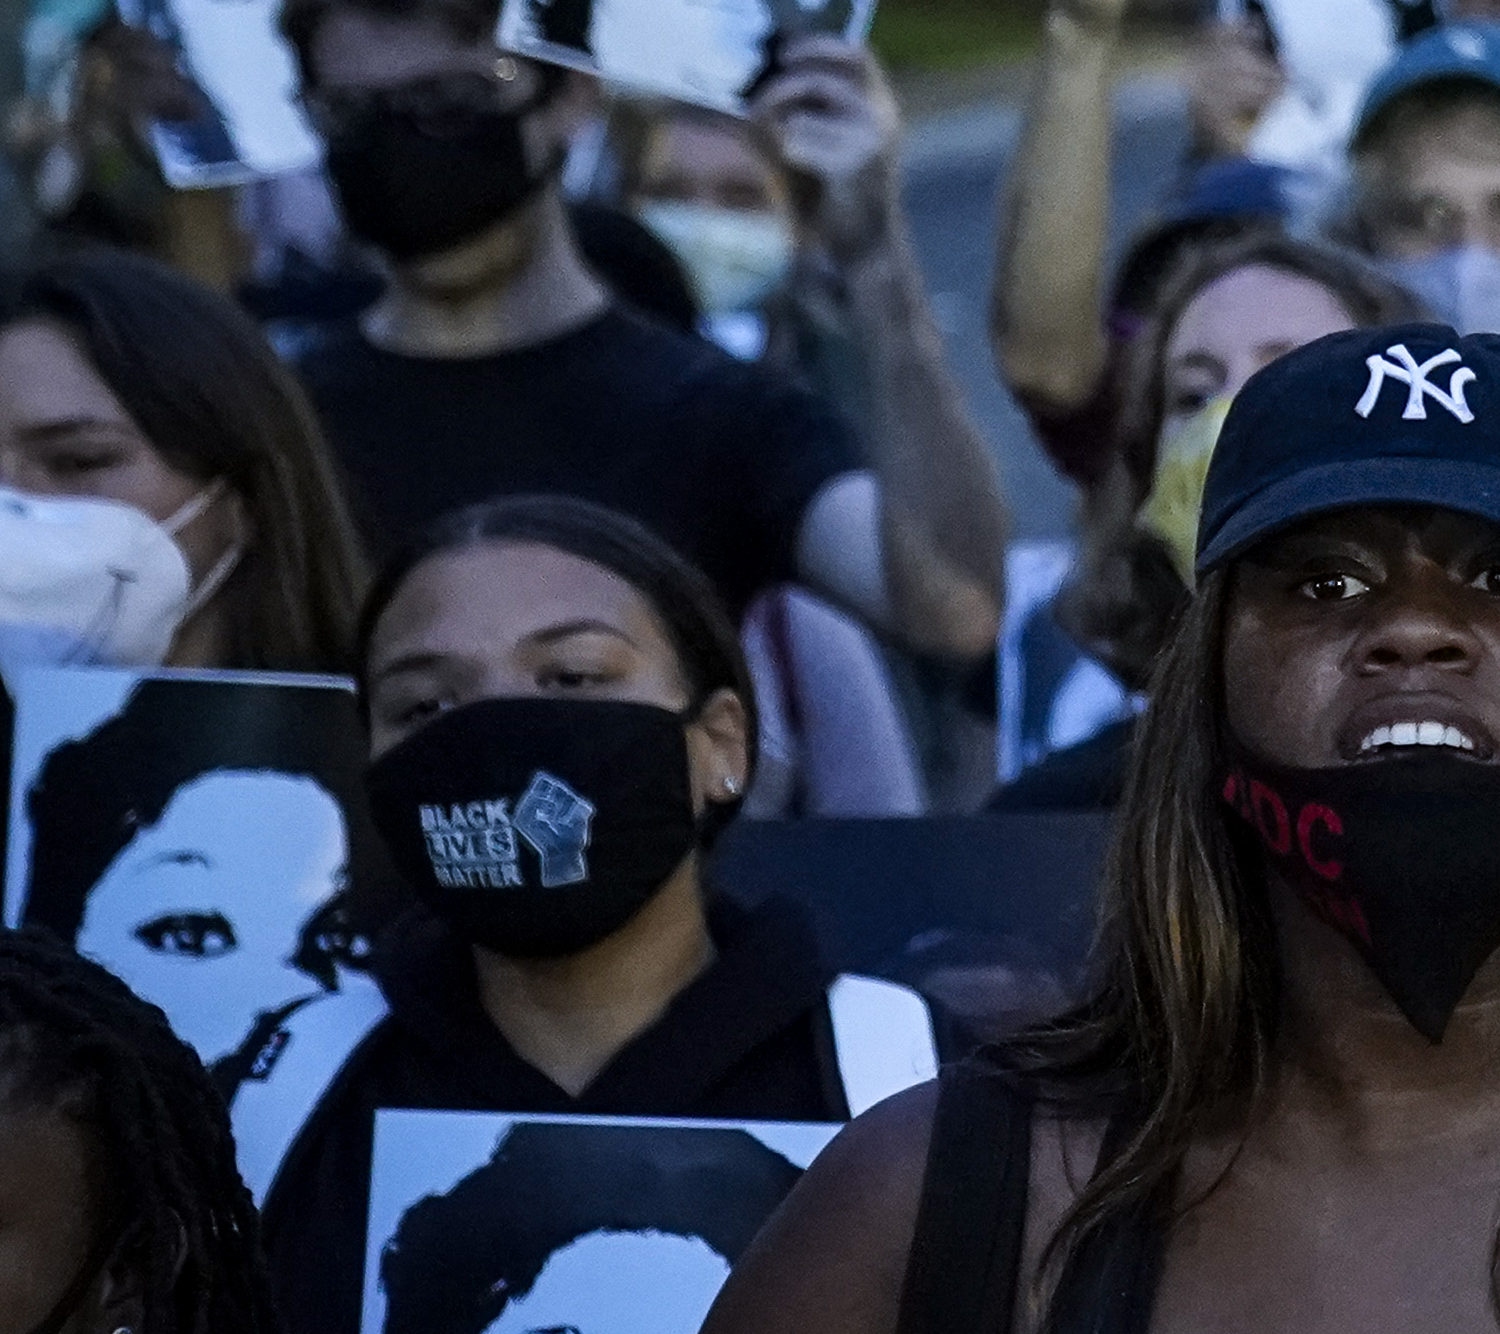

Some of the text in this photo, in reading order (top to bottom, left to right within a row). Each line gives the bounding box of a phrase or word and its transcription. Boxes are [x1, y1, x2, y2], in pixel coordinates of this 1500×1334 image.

[1355, 343, 1477, 424] NY
[419, 798, 512, 829] BLACK
[425, 827, 517, 863] LIVES
[433, 863, 524, 888] MATTER
